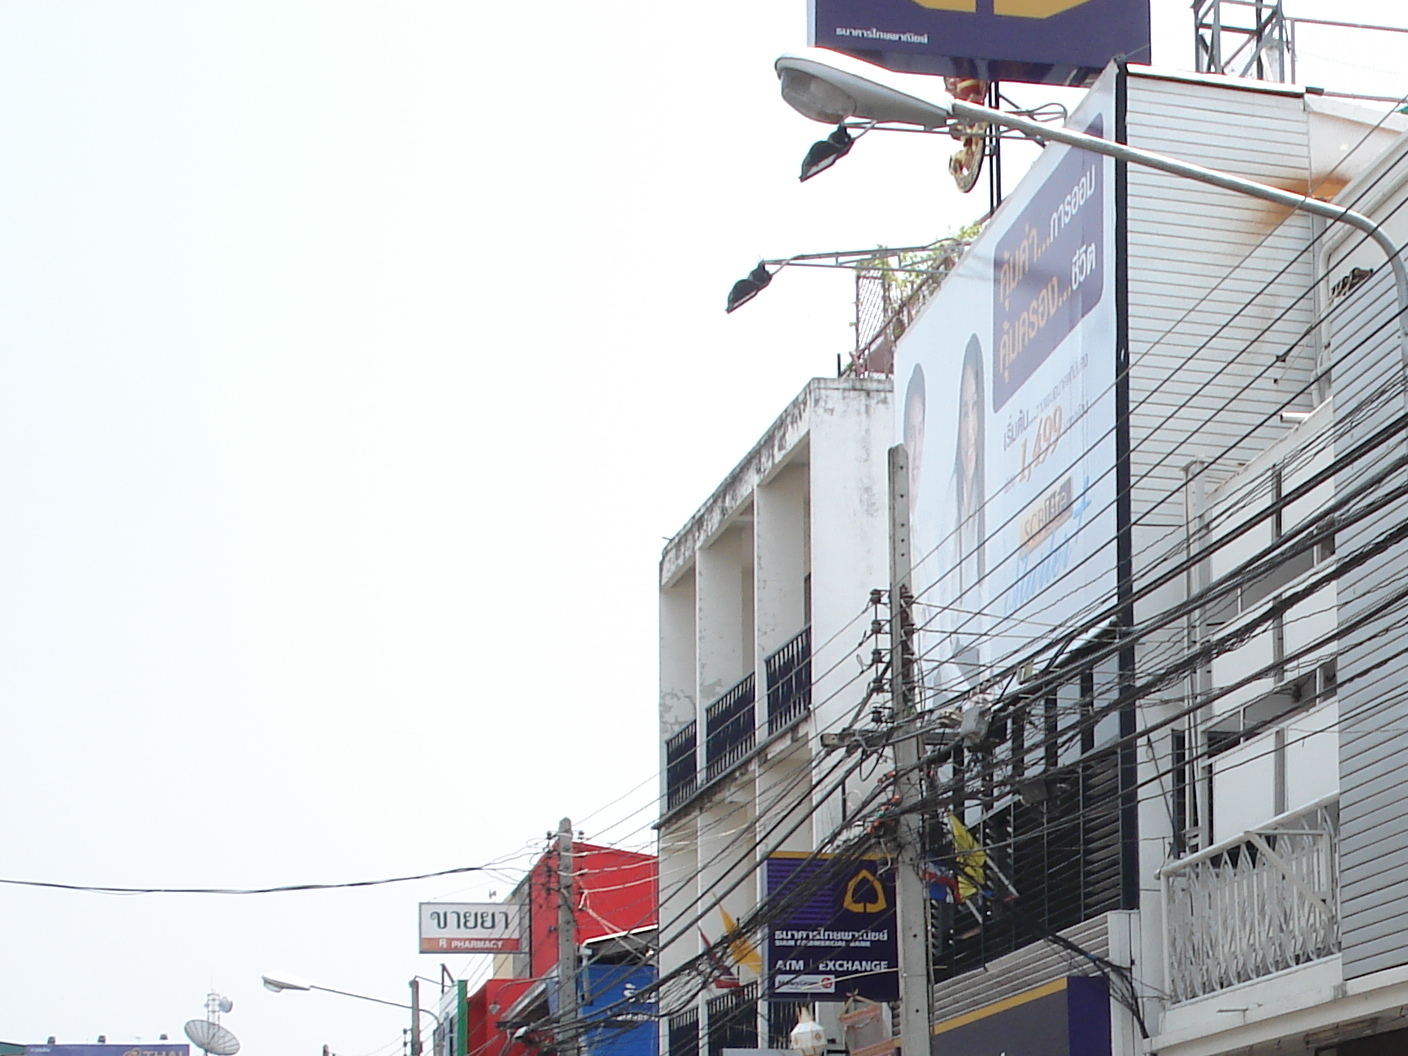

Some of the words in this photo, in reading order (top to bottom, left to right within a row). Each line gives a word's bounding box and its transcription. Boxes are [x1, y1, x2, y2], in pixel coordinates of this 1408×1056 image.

[430, 911, 509, 930] ขายยา
[451, 940, 503, 949] PHARMACY
[775, 960, 804, 971] ATM
[818, 960, 888, 972] EXCHANGE
